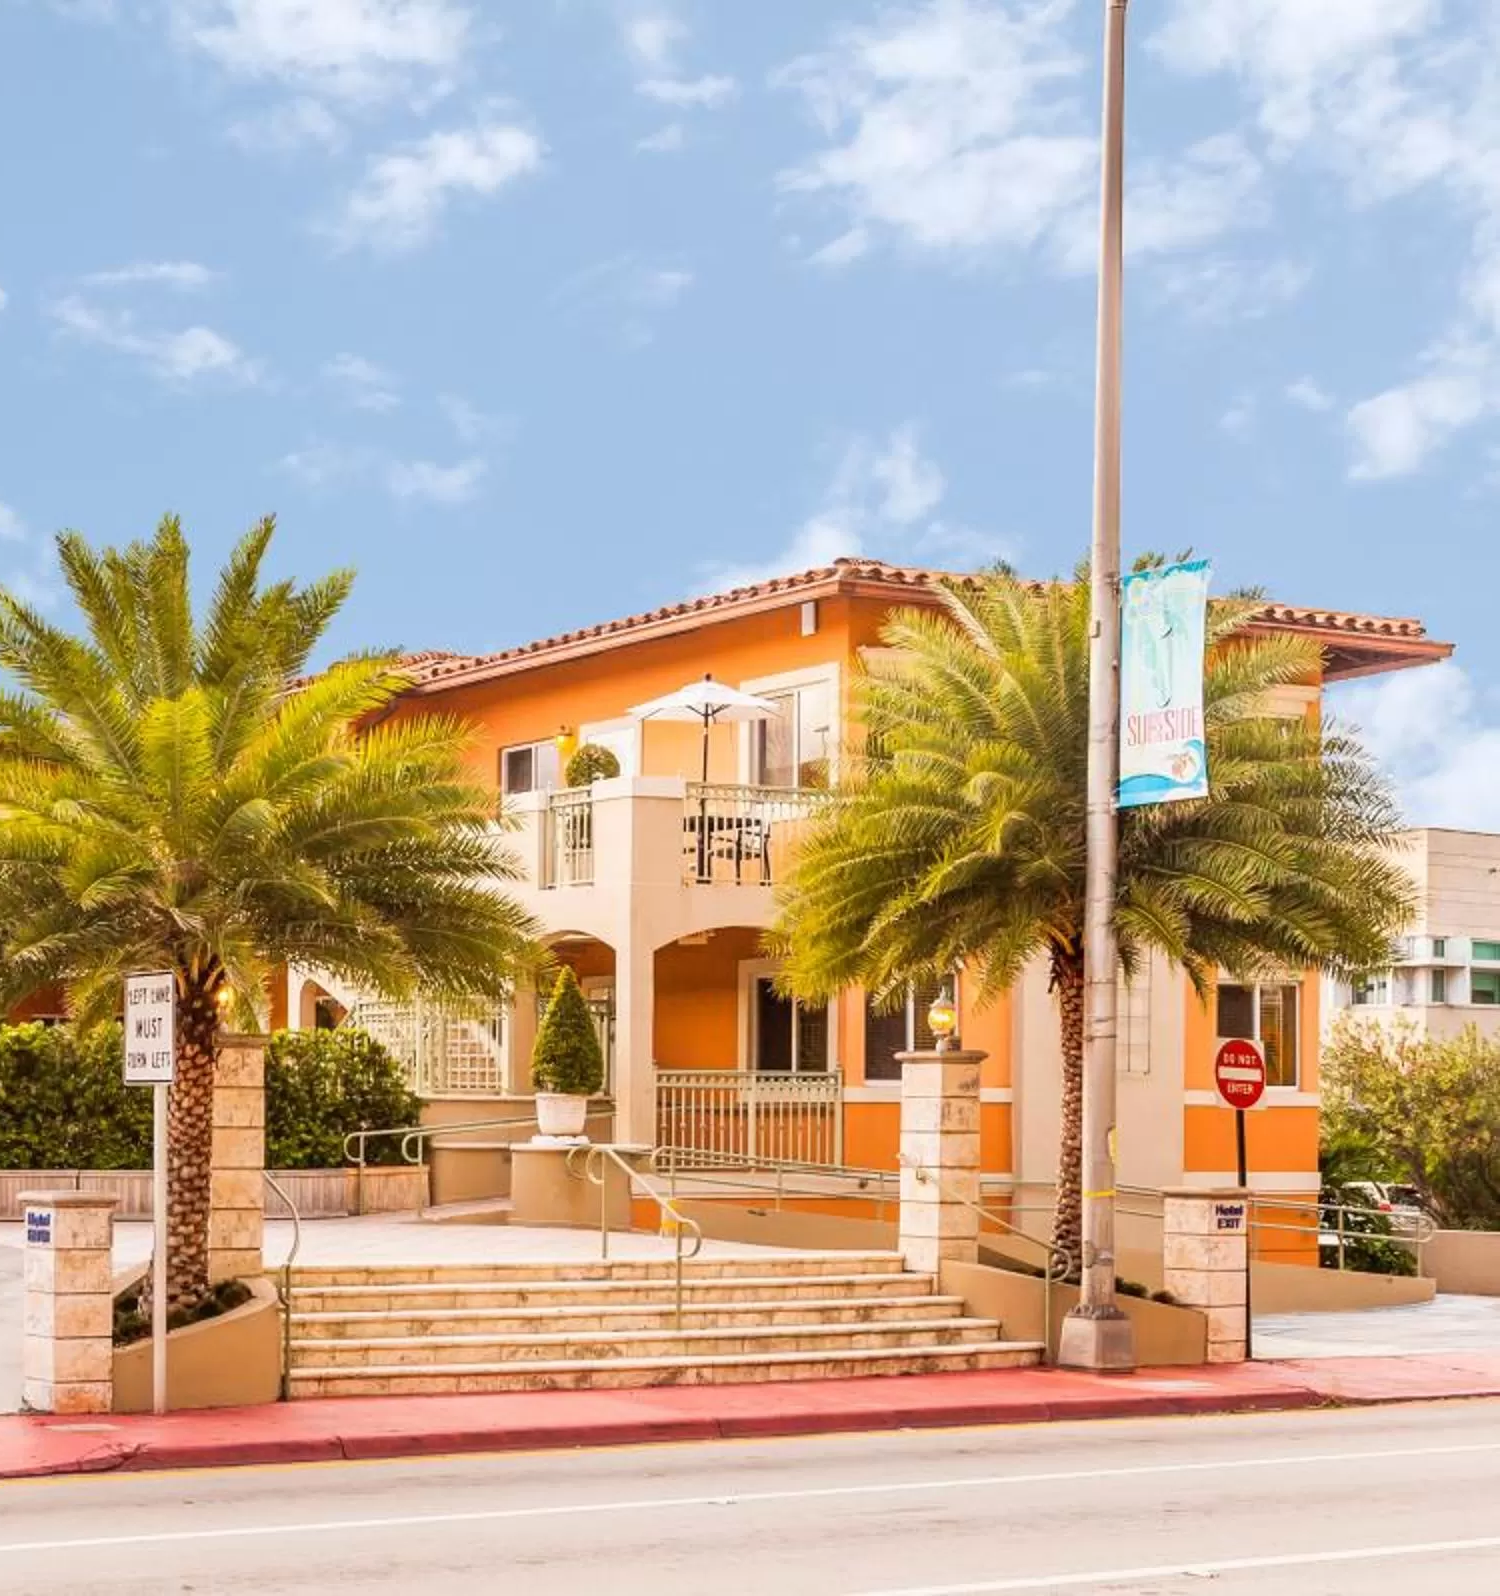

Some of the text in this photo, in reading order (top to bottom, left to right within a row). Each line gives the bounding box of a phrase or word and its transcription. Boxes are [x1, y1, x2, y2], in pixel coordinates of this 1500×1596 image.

[129, 985, 171, 1006] LEFT LANE
[135, 1017, 163, 1040] MUST
[127, 1051, 171, 1069] TURN LEFT
[1223, 1053, 1257, 1066] DO NOT
[1227, 1081, 1254, 1096] ENTER
[1215, 1204, 1244, 1217] Hotel
[1217, 1217, 1241, 1230] EXIT
